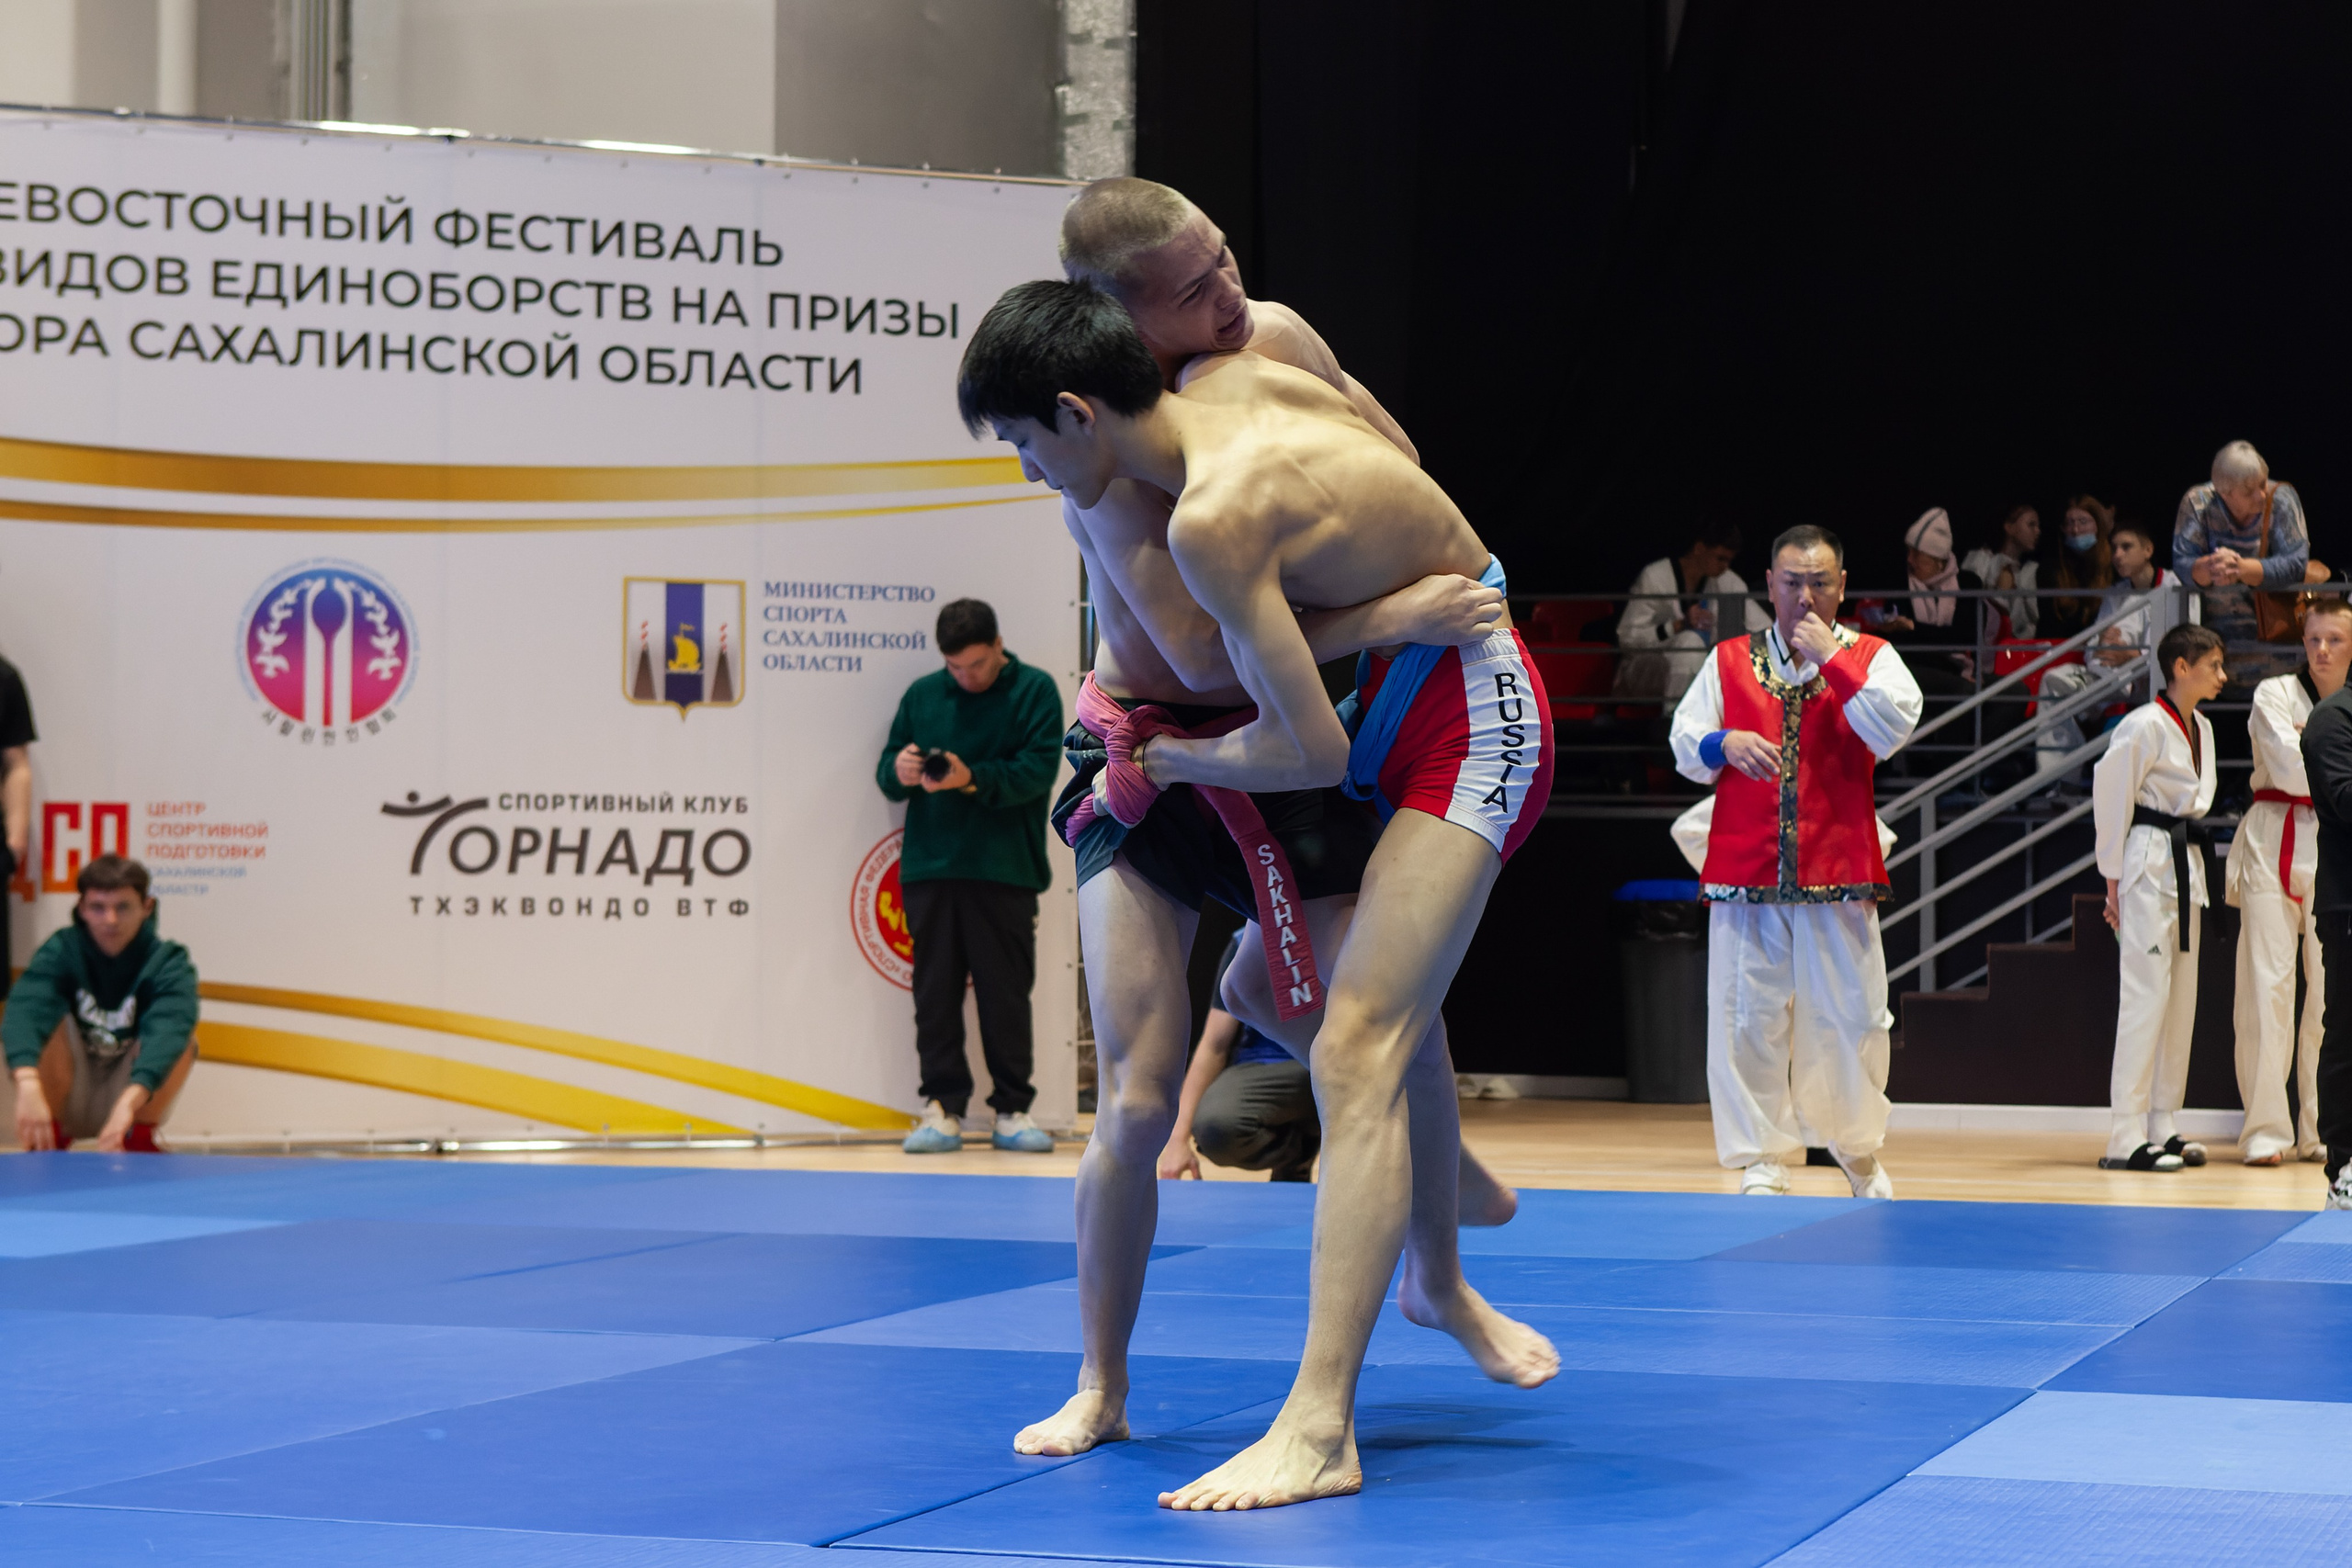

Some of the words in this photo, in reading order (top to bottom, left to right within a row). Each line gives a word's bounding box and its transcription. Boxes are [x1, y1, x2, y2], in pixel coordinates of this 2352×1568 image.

[0, 183, 413, 244] ЕВОСТОЧНЫЙ
[434, 208, 783, 266] ФЕСТИВАЛЬ
[0, 248, 189, 299] ИДОВ
[212, 260, 651, 321] ЕДИНОБОРСТВ
[673, 286, 748, 327] НА
[768, 292, 959, 339] ПРИЗЫ
[0, 313, 109, 357] ОРА
[130, 320, 579, 380] САХАЛИНСКОЙ
[600, 345, 863, 395] ОБЛАСТИ
[764, 581, 935, 603] МИНИСТЕРСТВО
[763, 605, 847, 624] СПОРТА
[763, 630, 926, 650] САХАЛИНСКОЙ
[763, 654, 862, 672] ОБЛАСТИ
[1482, 672, 1526, 813] RUSSIA
[146, 801, 206, 817] ЦЕНТР
[498, 793, 674, 813] СПОРТИВНЫЙ
[684, 796, 749, 814] КЛУБ
[147, 822, 268, 838] СПОРТИВНОЙ
[9, 802, 130, 902] СП
[146, 843, 266, 860] ПОДГОТОВКИ
[410, 897, 650, 919] ТХЭКВОНДО
[677, 897, 750, 917] ВТФ
[1257, 843, 1313, 1007] SAKHALIN
